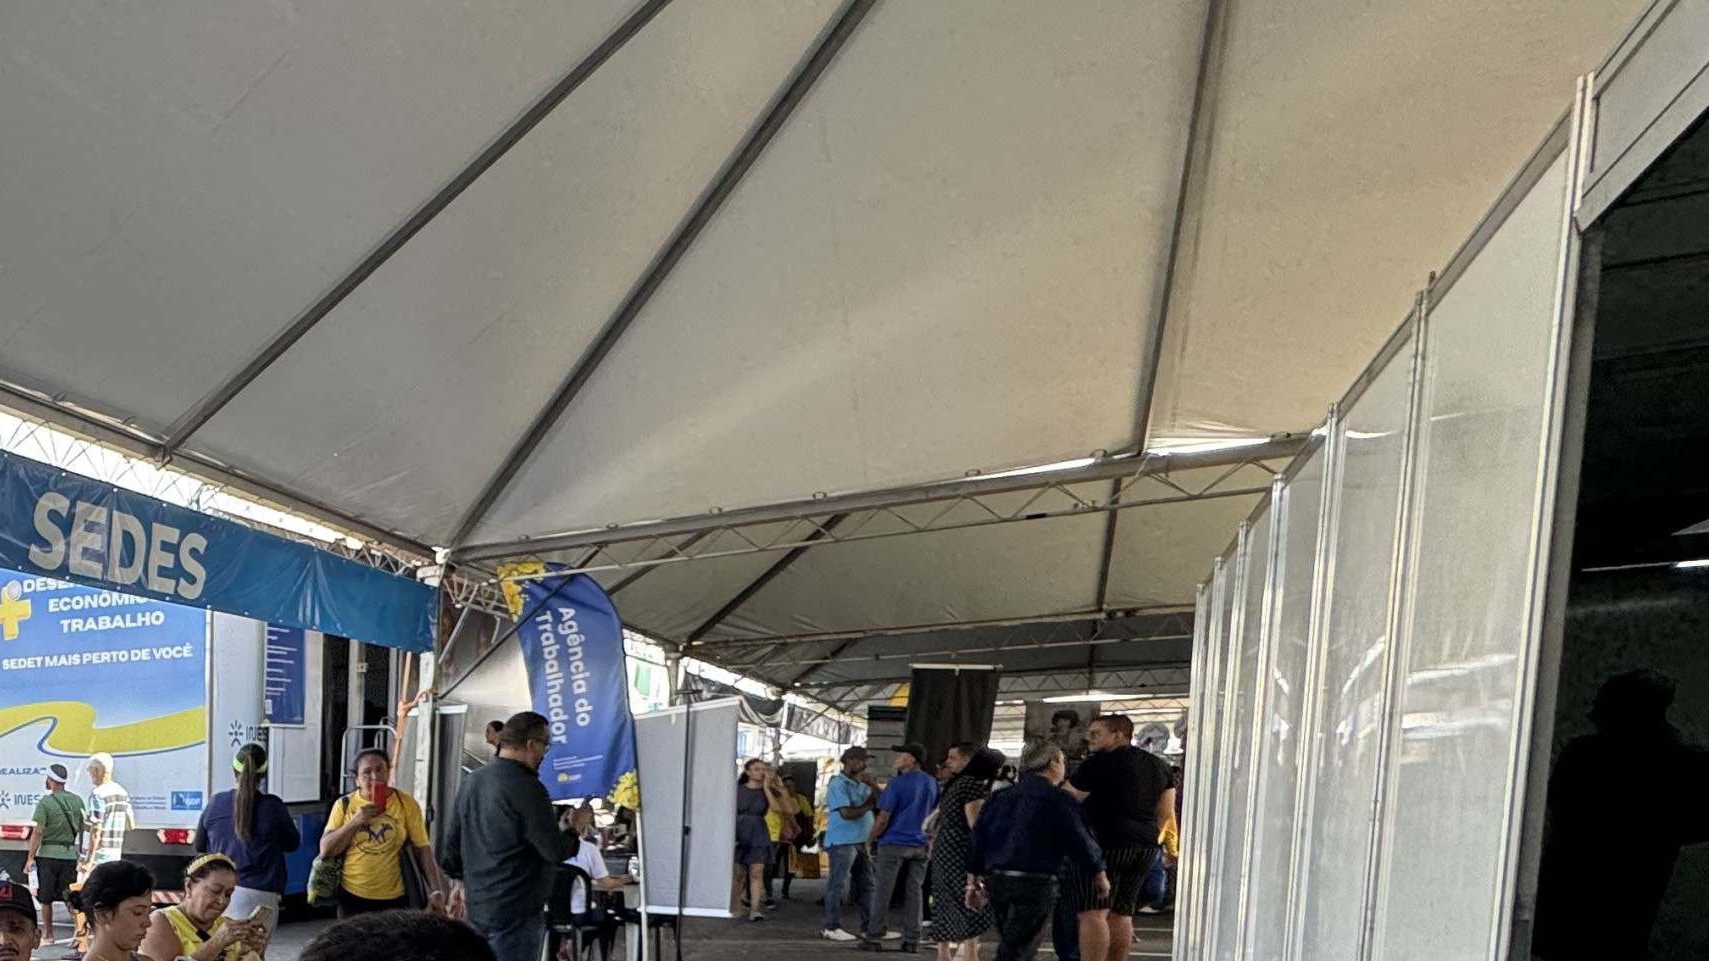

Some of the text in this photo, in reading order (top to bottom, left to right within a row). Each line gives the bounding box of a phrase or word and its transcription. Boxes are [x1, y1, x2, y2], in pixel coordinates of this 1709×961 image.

[28, 491, 208, 600] SEDES
[1, 643, 194, 671] SEDET MAIS PERTO DE VOCÊ
[59, 610, 165, 633] TRABALHO
[557, 607, 591, 695] Agência
[574, 698, 594, 727] do
[535, 610, 570, 744] Trabalhador
